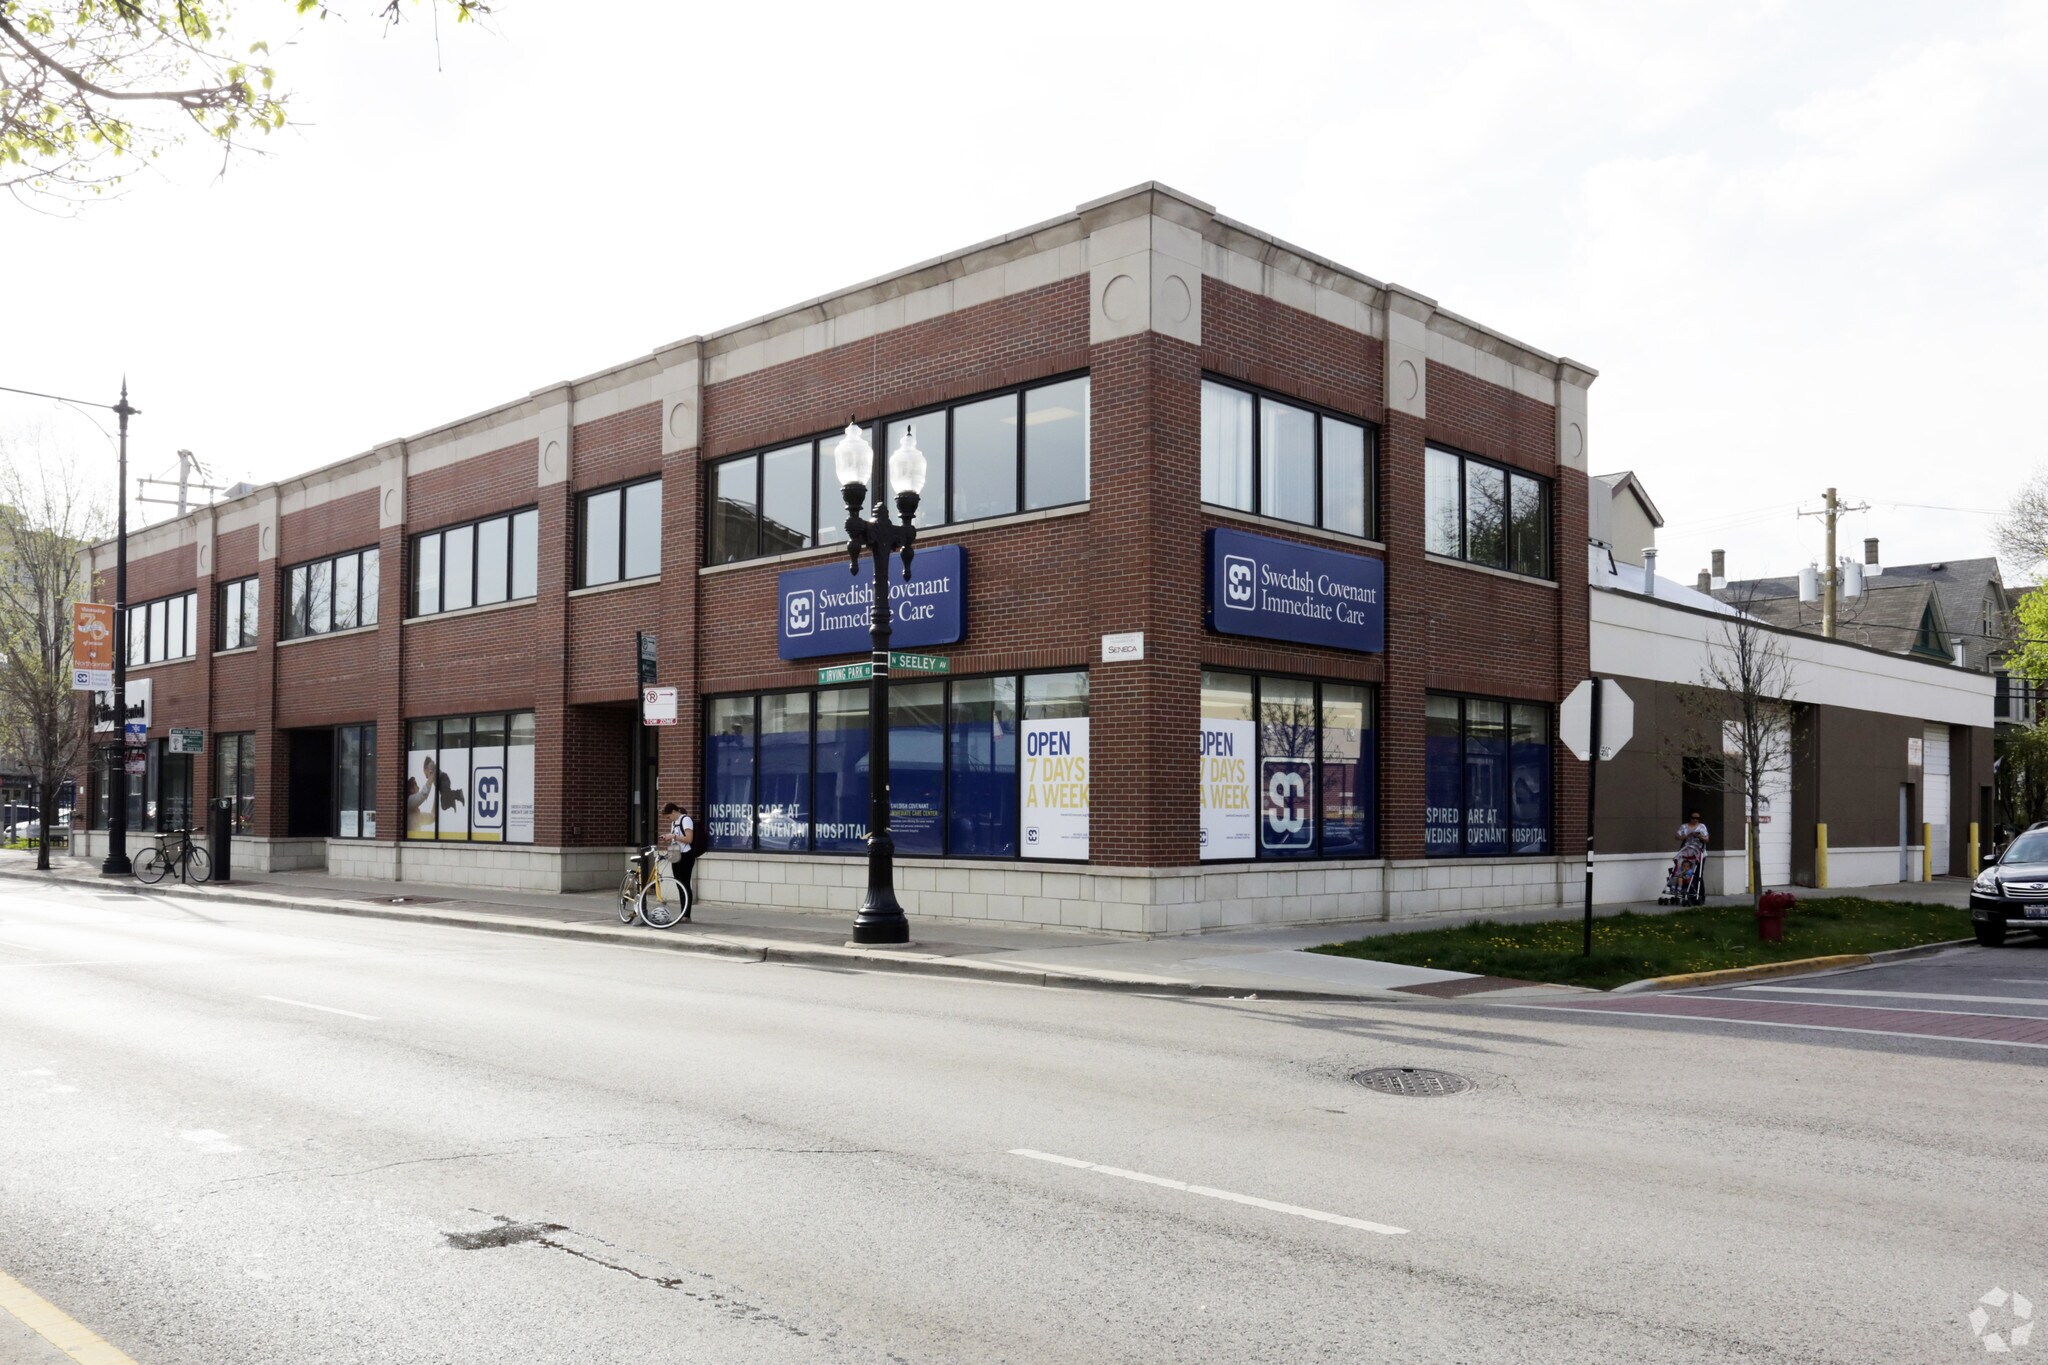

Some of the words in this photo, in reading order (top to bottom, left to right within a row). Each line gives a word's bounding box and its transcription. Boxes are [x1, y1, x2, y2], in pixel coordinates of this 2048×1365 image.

[819, 582, 874, 609] Swedish
[888, 576, 950, 600] ovenant
[1261, 563, 1314, 594] Swedish
[1318, 574, 1377, 604] Covenant
[899, 601, 935, 622] Care
[1261, 588, 1333, 621] Immediate
[1336, 602, 1365, 625] Care
[826, 668, 846, 682] IRVING
[848, 665, 864, 680] PARK
[892, 656, 897, 664] N
[899, 654, 936, 670] SEELEY
[940, 661, 947, 669] AV
[1027, 730, 1071, 757] OPEN
[1026, 757, 1038, 783] 7
[1042, 756, 1086, 783] DAYS
[1210, 757, 1246, 784] DAYS
[1026, 783, 1038, 809] A
[1042, 783, 1089, 809] WEEK
[1210, 784, 1250, 809] WEEK
[709, 803, 753, 819] INSPIRED
[758, 803, 784, 819] CARE
[787, 803, 800, 819] AT
[1426, 807, 1459, 824] SPIRED
[1467, 808, 1484, 824] ARE
[1487, 808, 1497, 824] AT
[708, 821, 753, 837] SWEDISH
[757, 822, 809, 839] COVENANT
[815, 823, 867, 840] HOSPITAL
[1425, 827, 1459, 844] WEDISH
[1467, 827, 1507, 844] OVENANT
